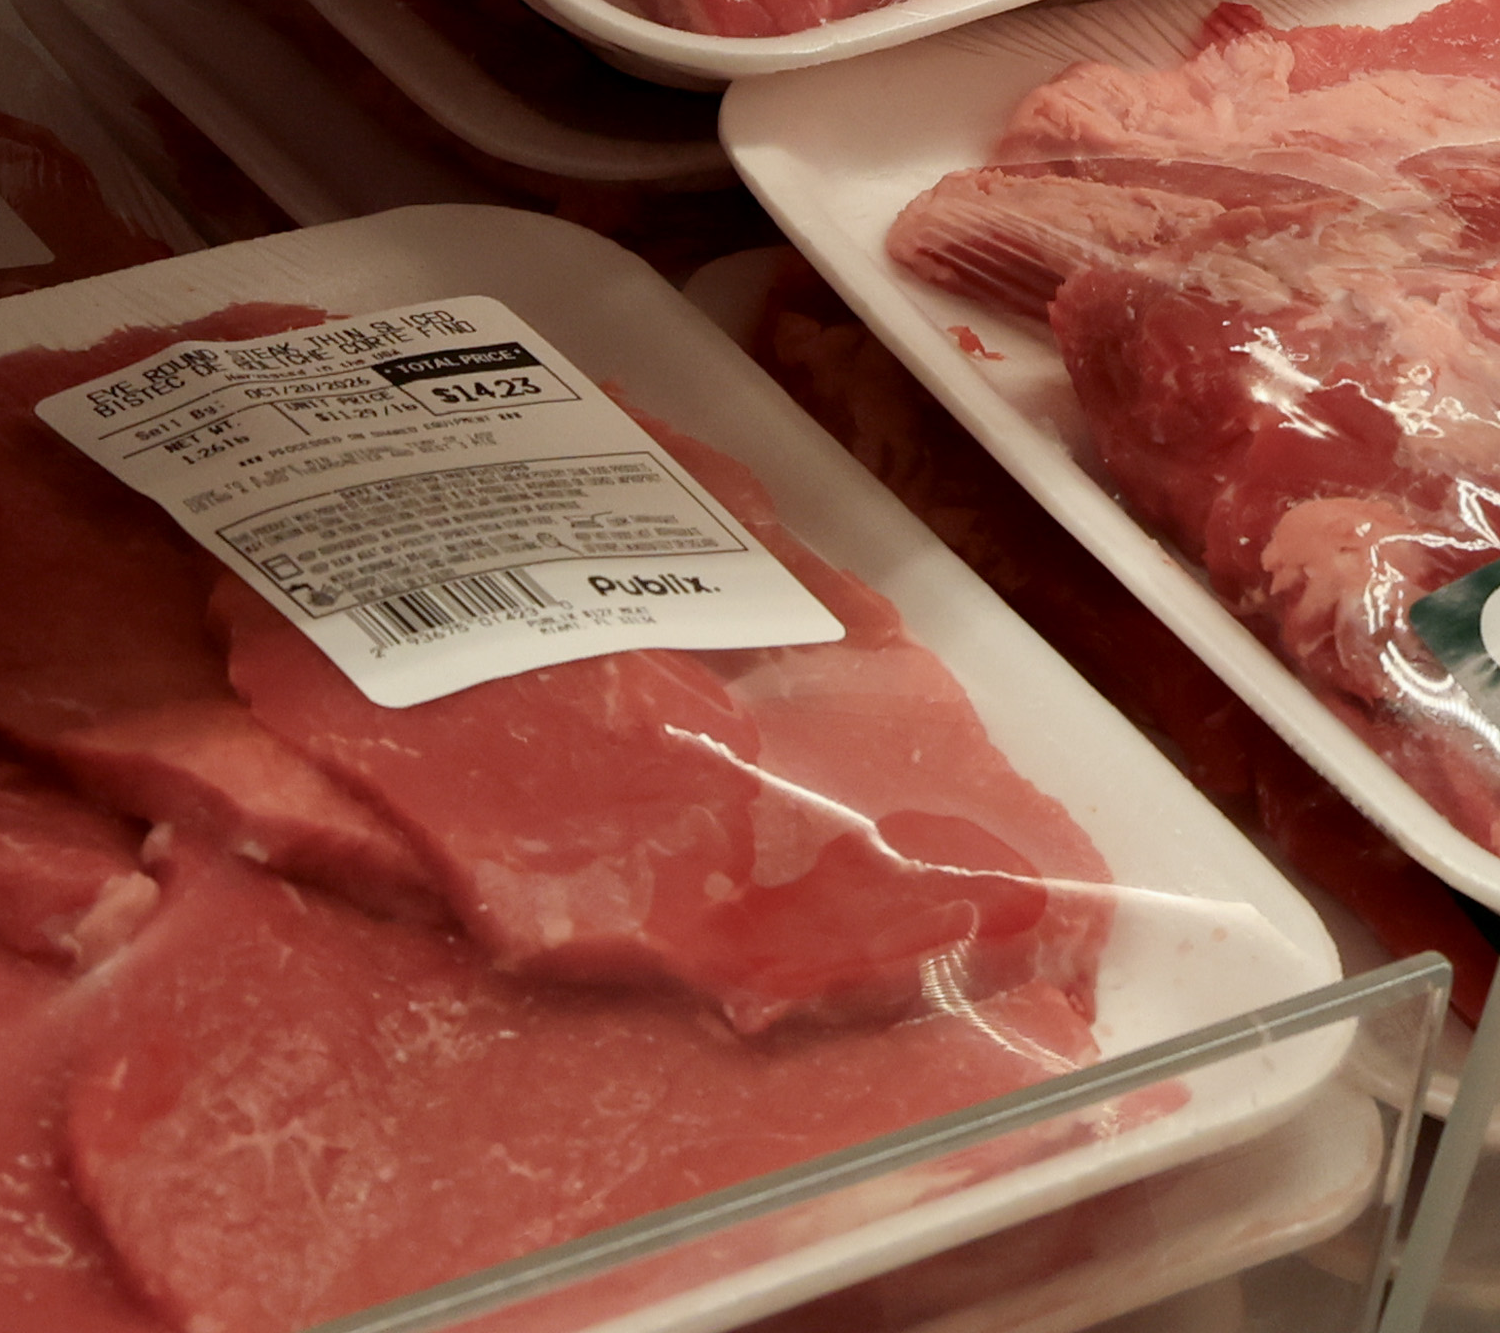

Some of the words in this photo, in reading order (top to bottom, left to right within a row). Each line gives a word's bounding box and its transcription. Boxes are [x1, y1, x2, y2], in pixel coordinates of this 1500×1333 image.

[86, 381, 134, 405] EYE
[142, 349, 218, 381] ROUND
[304, 327, 365, 350] THIN
[370, 310, 454, 333] SLICED
[392, 359, 454, 374] TOTAL
[461, 350, 515, 365] PRICE
[93, 377, 186, 418] BISTEC
[191, 362, 226, 377] DE
[340, 332, 414, 355] CORTE
[284, 397, 328, 411] UNIT
[340, 391, 394, 405] PRICE
[135, 420, 181, 441] Sell
[163, 436, 201, 453] NET
[208, 419, 241, 435] WT.
